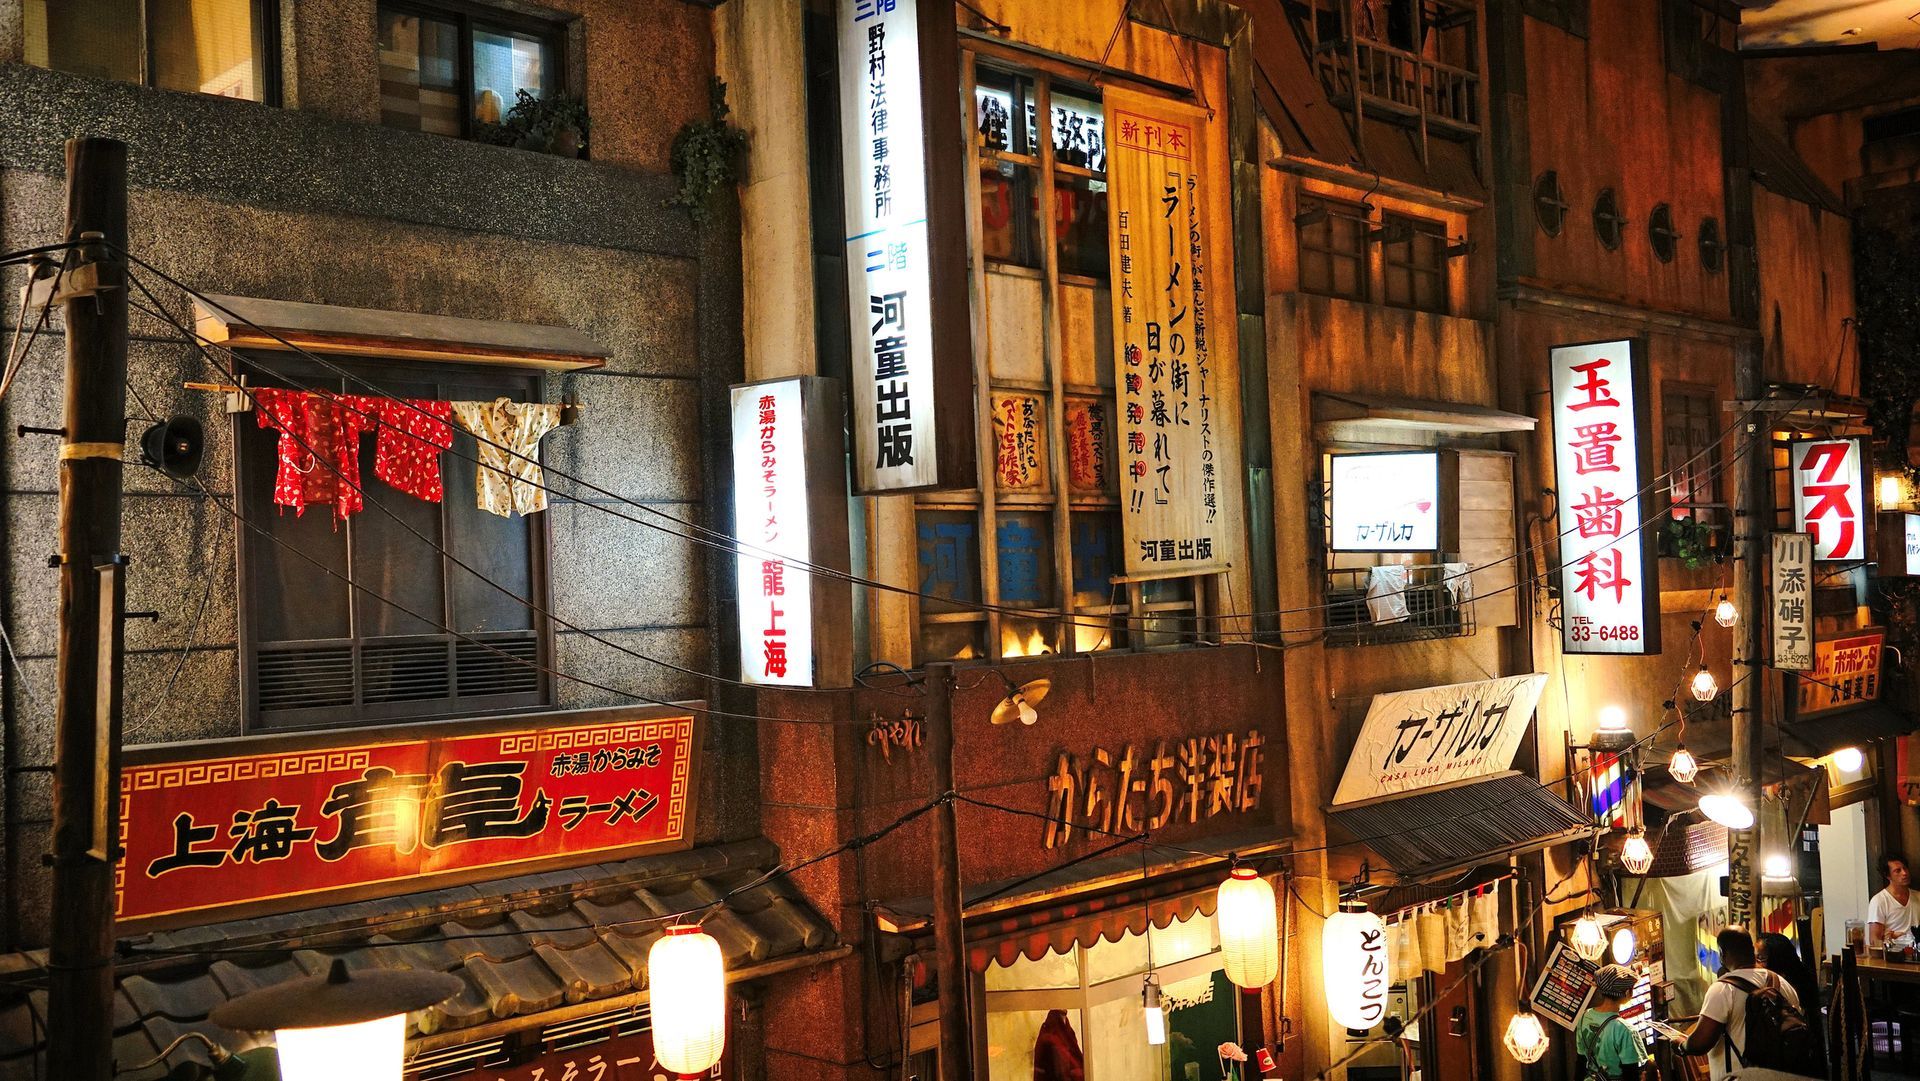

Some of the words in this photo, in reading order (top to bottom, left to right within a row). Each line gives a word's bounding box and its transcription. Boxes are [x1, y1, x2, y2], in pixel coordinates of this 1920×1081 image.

[868, 22, 892, 219] 野村法律事務所
[1121, 120, 1186, 151] 新刊本
[870, 290, 914, 470] 河童出版
[759, 395, 779, 543] 赤湯からみそラーメン
[1566, 358, 1632, 605] 玉置歯科
[1800, 443, 1855, 559] クスリ
[1141, 537, 1213, 562] 河童出版
[1356, 520, 1414, 542] カーザルカ
[762, 558, 788, 678] 龍上海
[1571, 625, 1639, 642] 33-6488
[1572, 616, 1594, 625] TEL
[1779, 540, 1805, 650] 川添硝子
[550, 744, 661, 778] 赤湯からみそ
[1380, 772, 1408, 784] CASA
[1414, 765, 1440, 778] LUCA
[1446, 757, 1483, 771] MILANO
[1383, 693, 1515, 771] カーザルカ
[557, 787, 660, 831] ラーメン
[1043, 729, 1266, 851] からたち洋装店
[1360, 929, 1385, 1021] とんこつ
